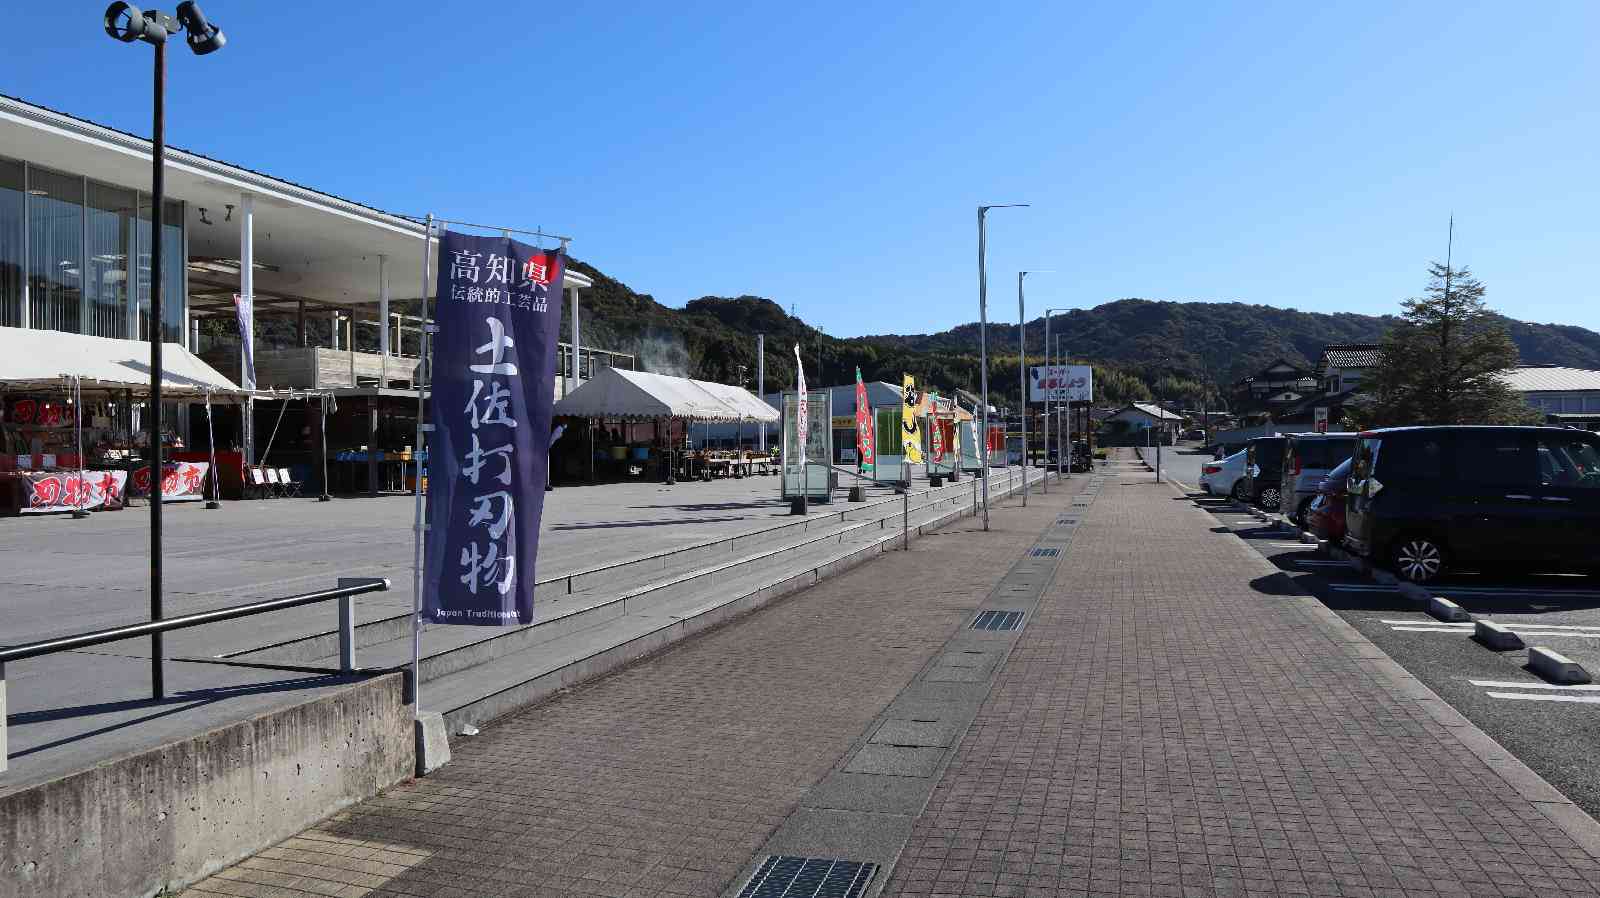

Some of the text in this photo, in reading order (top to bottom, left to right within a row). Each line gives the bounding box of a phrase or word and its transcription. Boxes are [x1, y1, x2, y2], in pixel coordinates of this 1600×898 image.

[449, 249, 549, 292] 高知県
[451, 284, 548, 313] 伝統的工芸品
[460, 316, 518, 595] 土佐打刃物
[30, 472, 119, 509] 刃物市
[436, 608, 463, 619] Japan
